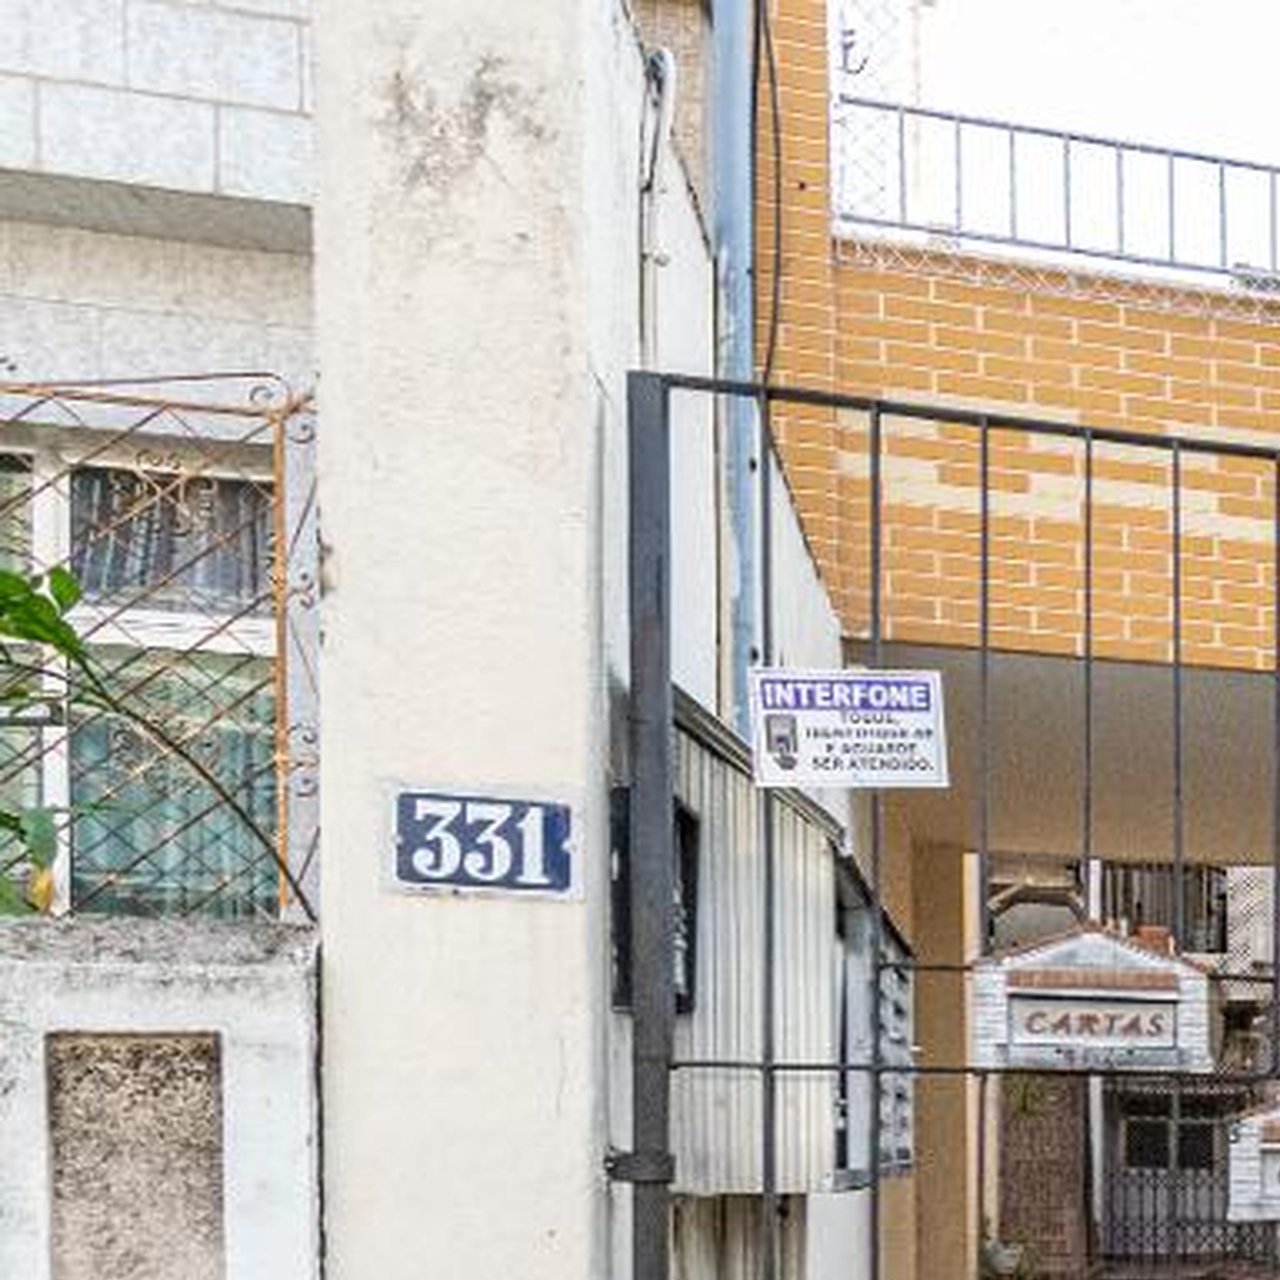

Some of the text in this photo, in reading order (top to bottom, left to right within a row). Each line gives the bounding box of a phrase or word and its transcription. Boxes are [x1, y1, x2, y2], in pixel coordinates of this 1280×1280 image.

[764, 682, 929, 708] INTERFONE
[412, 799, 551, 885] 331
[1024, 1012, 1165, 1037] CARTAS
